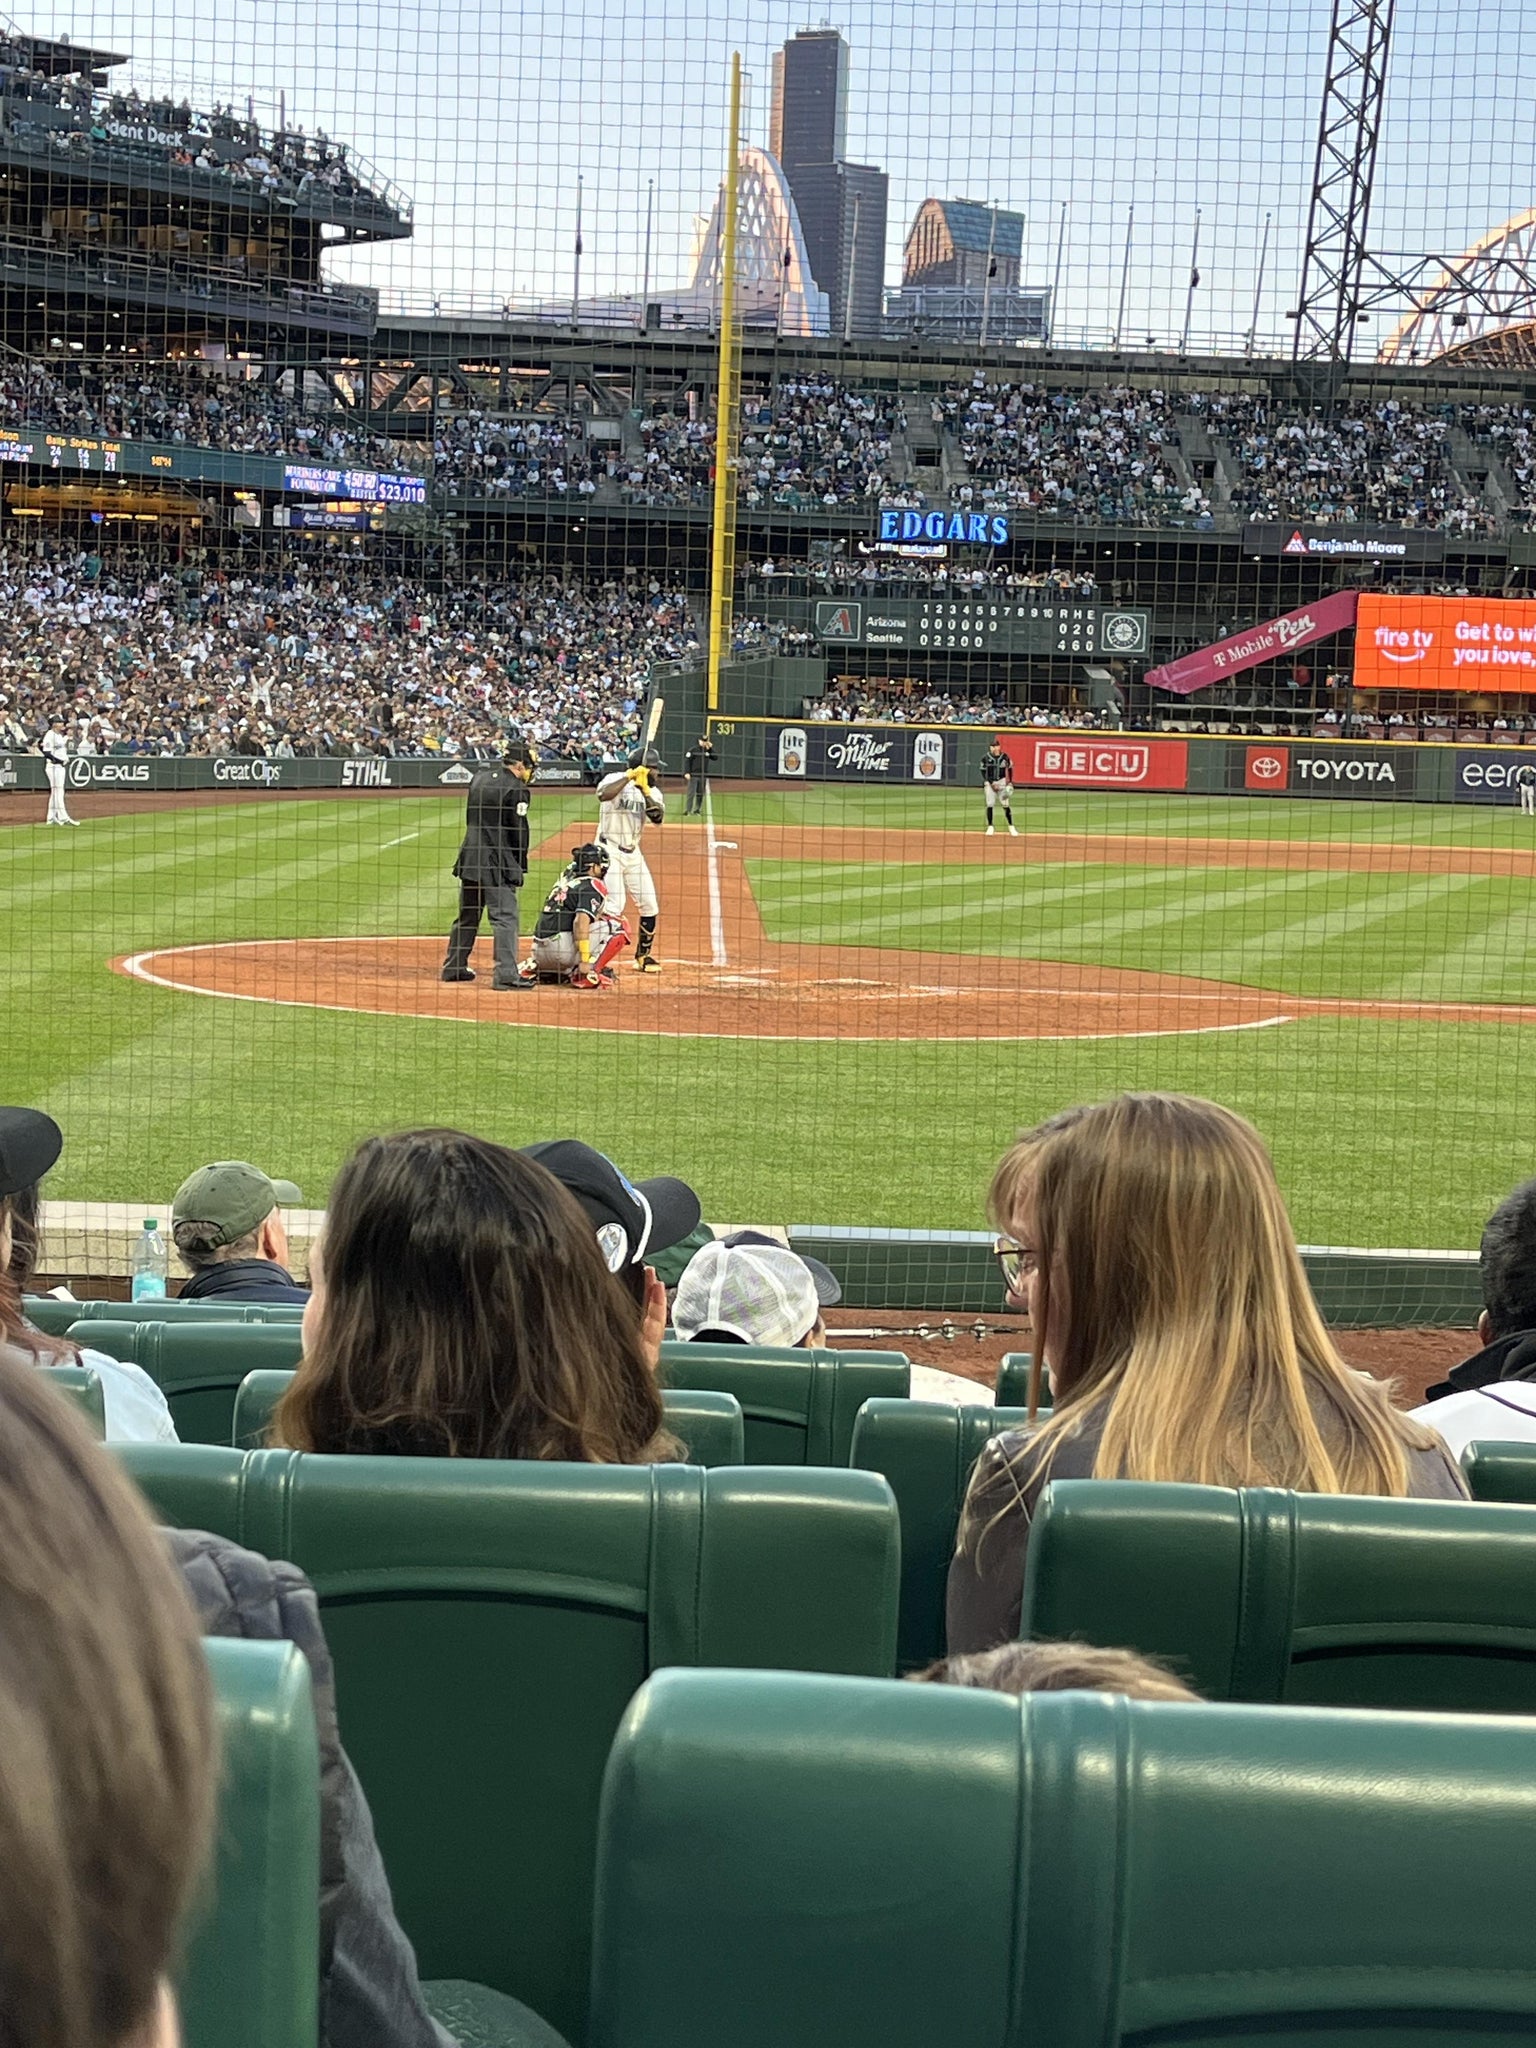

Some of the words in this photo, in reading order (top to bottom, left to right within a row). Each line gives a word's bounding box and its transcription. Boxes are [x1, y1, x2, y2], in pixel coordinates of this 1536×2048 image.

[147, 125, 183, 147] Deck
[45, 434, 67, 447] Balls
[69, 437, 98, 450] Strikes
[101, 441, 121, 453] Total
[379, 483, 426, 503] $23,010
[1308, 538, 1364, 554] Benjamin
[1366, 540, 1406, 555] Moore
[923, 604, 929, 613] 1
[935, 604, 943, 614] 2
[949, 604, 957, 615] 3
[962, 605, 970, 615] 4
[1003, 606, 1011, 616] 7
[1017, 607, 1025, 617] 8
[1031, 608, 1038, 617] 9
[1060, 609, 1068, 618] R
[1073, 609, 1082, 619] H
[1087, 610, 1095, 620] E
[865, 616, 906, 628] Arizona
[920, 618, 929, 629] 0
[934, 618, 943, 630] 0
[948, 619, 956, 630] 0
[961, 620, 970, 631] 0
[975, 620, 984, 631] 0
[988, 621, 997, 632] 0
[1059, 623, 1067, 634] 0
[1072, 624, 1081, 635] 2
[1086, 624, 1094, 635] 0
[1455, 621, 1490, 641] Get
[1494, 623, 1514, 642] to
[865, 632, 904, 644] Seattle
[920, 634, 928, 646] 0
[933, 634, 942, 646] 2
[947, 635, 956, 647] 2
[960, 636, 969, 647] 0
[974, 636, 983, 647] 0
[1058, 640, 1066, 651] 4
[1071, 640, 1080, 651] 6
[1085, 640, 1094, 651] 0
[1374, 627, 1410, 647] fire
[1413, 629, 1433, 647] tv
[1227, 635, 1274, 662] Mobile
[1453, 648, 1489, 666] you
[1492, 645, 1536, 668] love,
[716, 722, 735, 735] 331
[783, 734, 805, 750] Lite
[846, 733, 873, 745] IT'S
[918, 739, 941, 755] Lite
[827, 740, 893, 769] Miller
[857, 757, 890, 771] TIME
[92, 765, 149, 781] LEXUS
[213, 758, 250, 781] Great
[251, 759, 281, 786] Clips
[341, 760, 392, 785] STIHL
[1297, 759, 1396, 783] TOYOTA
